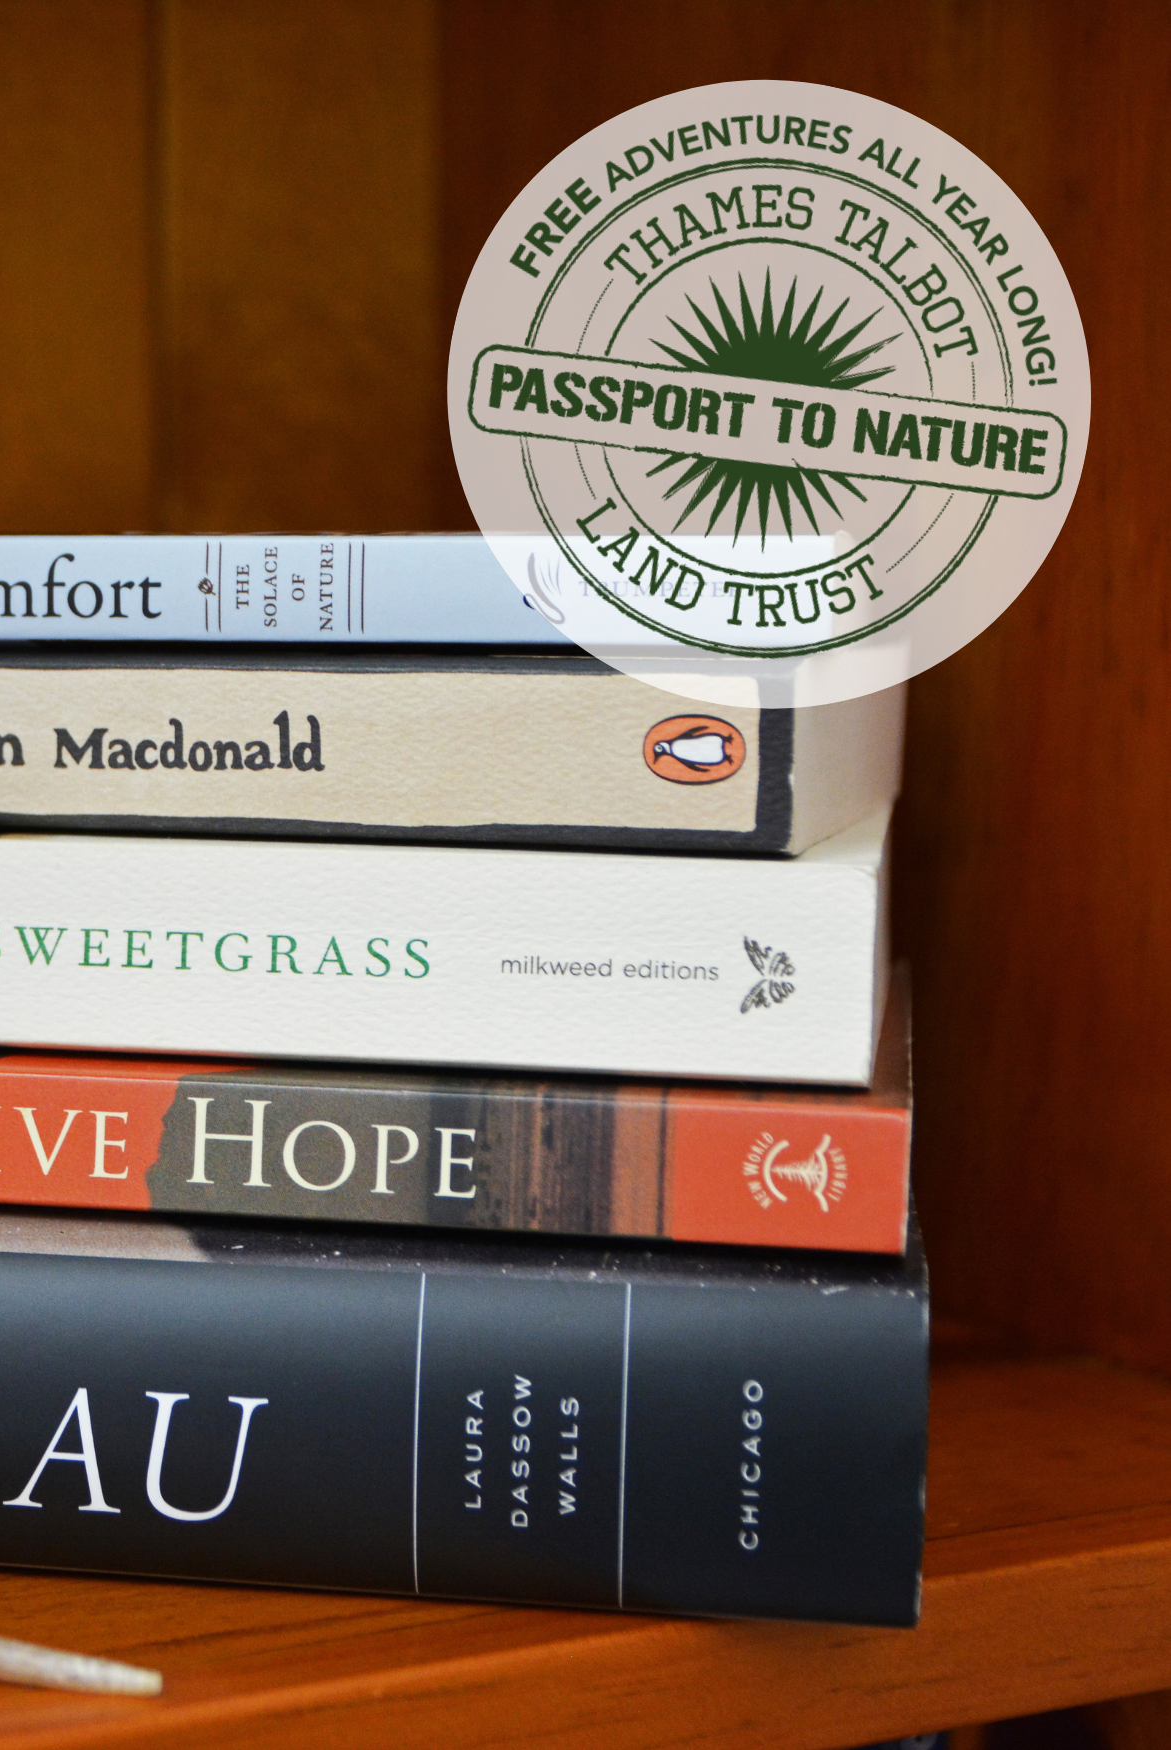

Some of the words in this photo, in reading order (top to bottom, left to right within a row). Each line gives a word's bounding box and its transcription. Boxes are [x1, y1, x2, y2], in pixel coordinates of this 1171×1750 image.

[236, 564, 250, 610] THE
[263, 547, 278, 628] SOLACE
[291, 573, 306, 602] OF
[319, 543, 334, 632] NATURE
[579, 580, 734, 598] TUMPEE
[53, 710, 326, 772] Macdonald
[501, 955, 613, 978] milkweed
[623, 959, 719, 981] editions
[465, 1389, 485, 1509] LAURA
[511, 1373, 533, 1528] DASSOW
[558, 1396, 580, 1515] WALLS
[738, 1379, 764, 1551] CHICAGO
